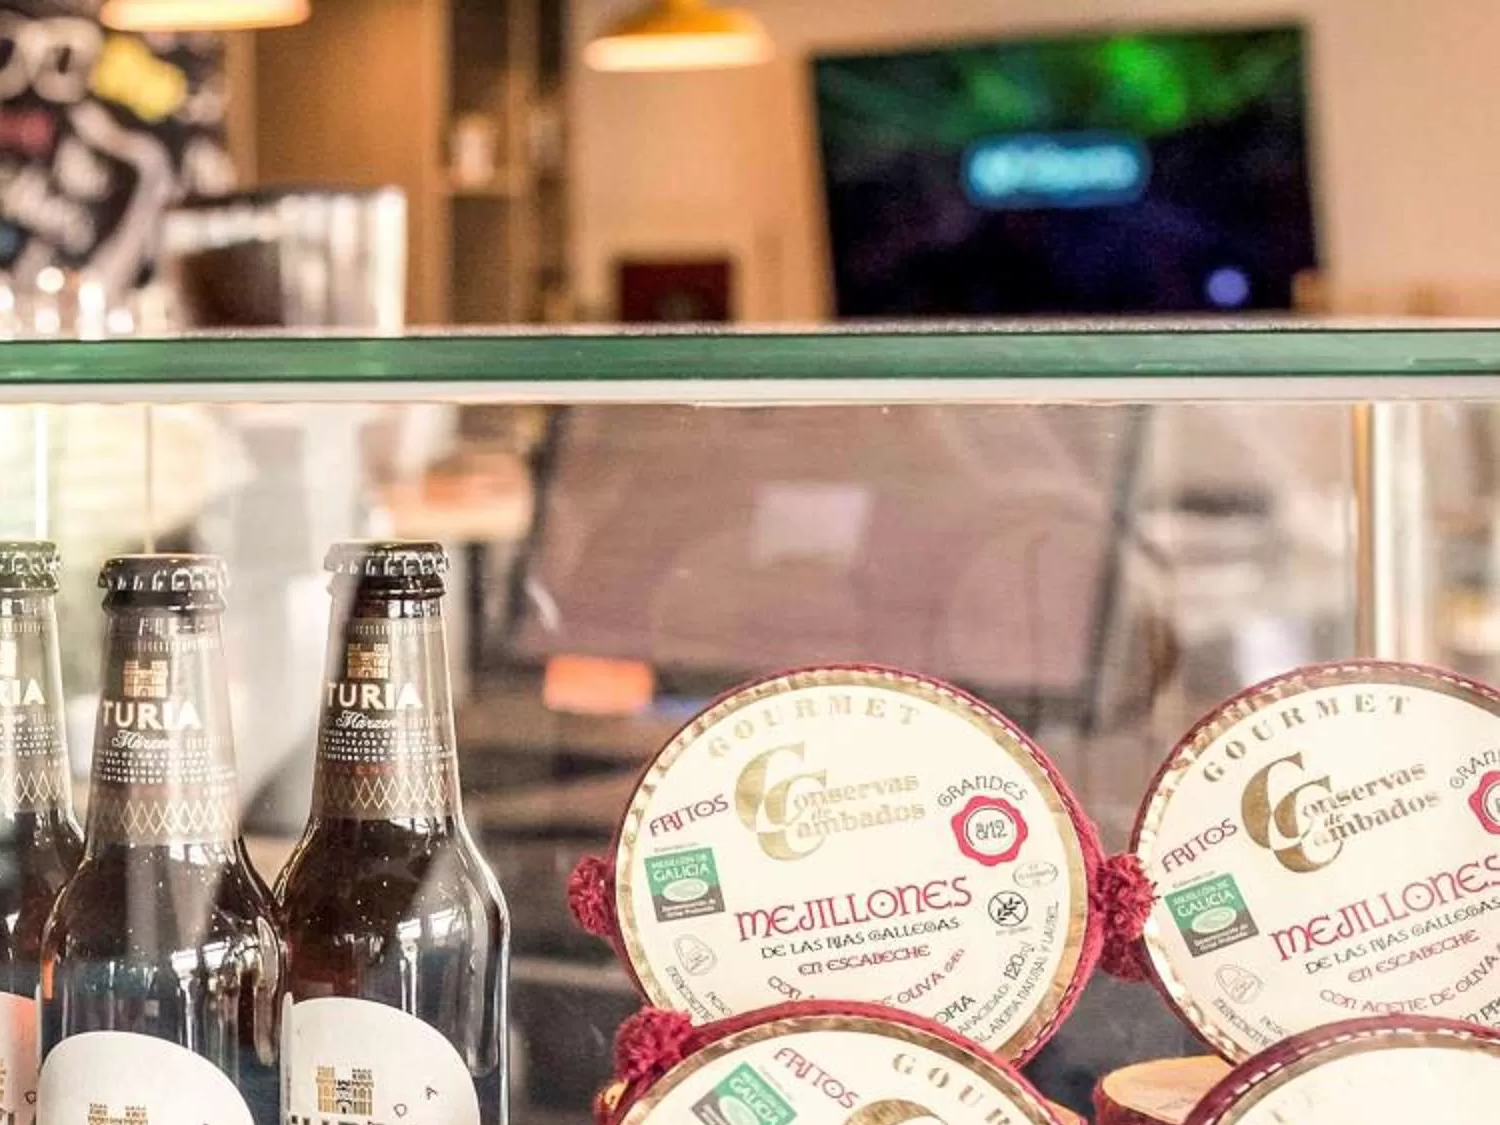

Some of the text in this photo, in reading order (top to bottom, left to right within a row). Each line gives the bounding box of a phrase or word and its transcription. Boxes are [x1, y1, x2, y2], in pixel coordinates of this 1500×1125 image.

[103, 700, 202, 731] TURIA
[327, 682, 425, 710] TURIA
[708, 695, 920, 758] GOURMET
[1202, 692, 1412, 784] GOURMET
[1449, 749, 1500, 789] GRAN
[937, 775, 1028, 808] GRANDES
[649, 793, 729, 838] FRITOS
[1161, 817, 1238, 873] FRITOS
[653, 861, 710, 882] GALICIA
[735, 876, 973, 942] MEJILLONES
[1176, 890, 1235, 918] GALICIA
[760, 945, 787, 960] DE
[789, 941, 824, 956] LAS
[867, 915, 962, 942] GALLEGAS
[825, 944, 932, 972] ESCABECHE
[1375, 929, 1481, 975] ESCABECHE
[1304, 959, 1332, 975] DE
[1333, 944, 1369, 965] LAS
[897, 970, 948, 1005] OLIVA
[1430, 986, 1457, 1007] DE
[1455, 955, 1500, 993] OLIVA
[773, 1046, 862, 1109] FRITOS
